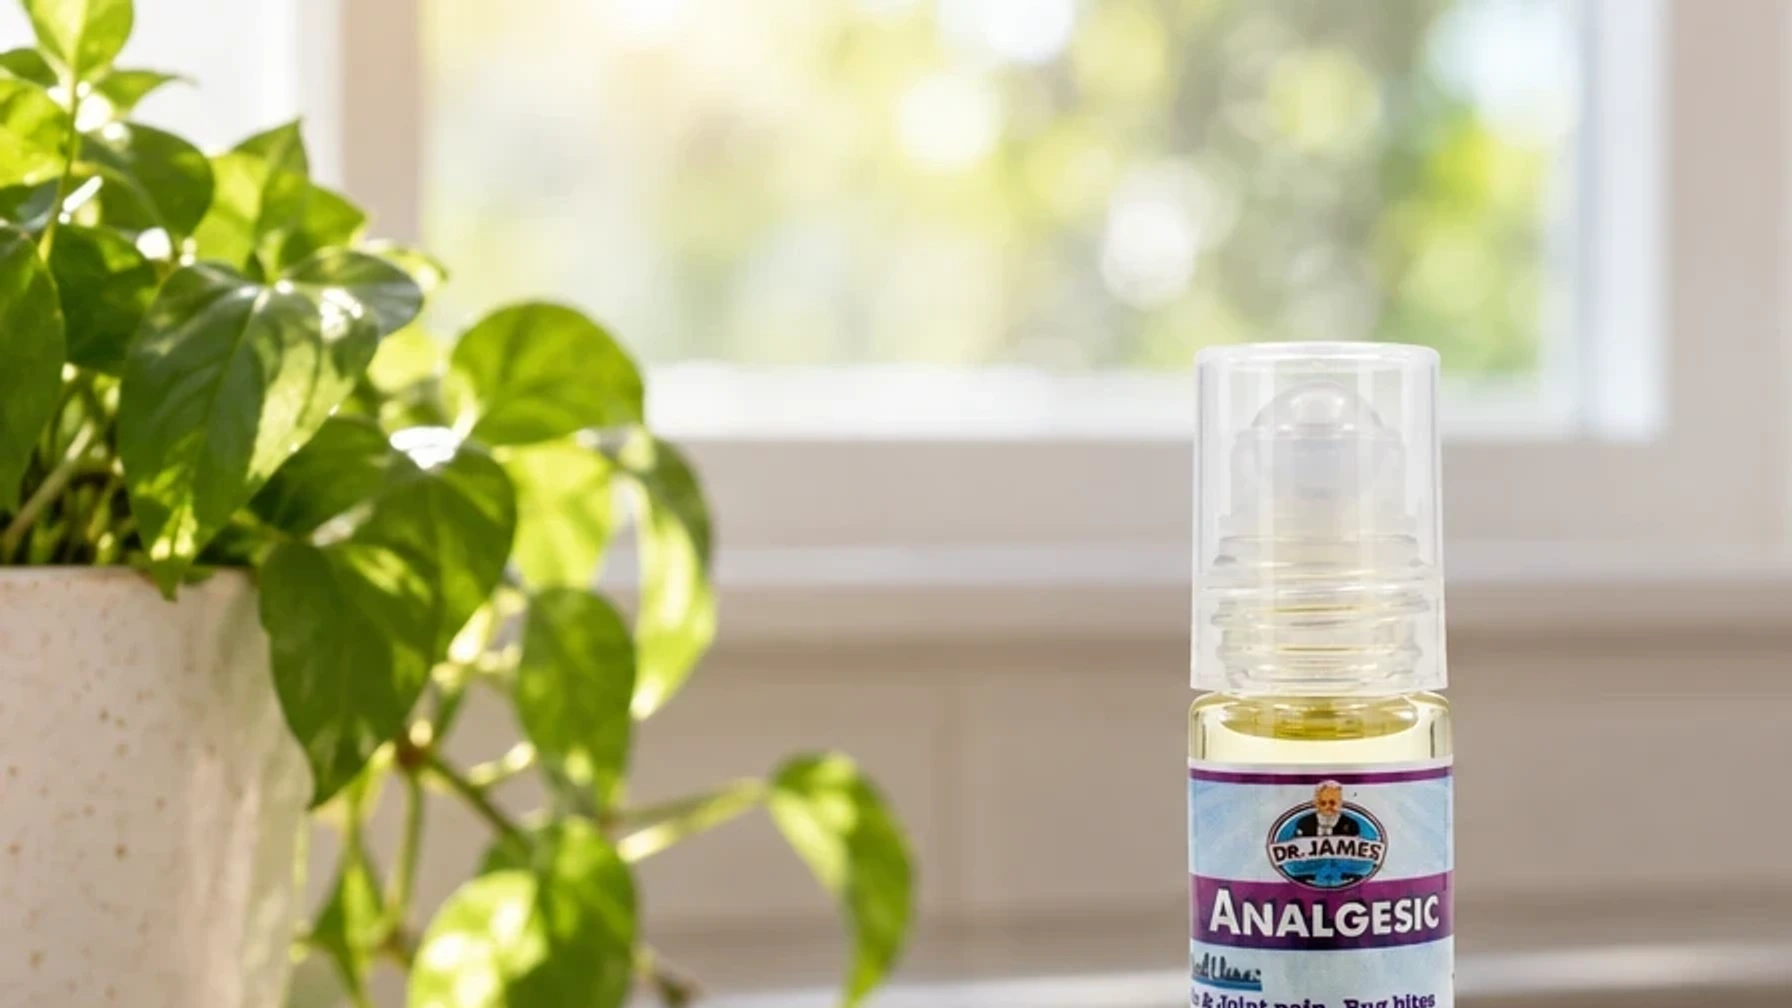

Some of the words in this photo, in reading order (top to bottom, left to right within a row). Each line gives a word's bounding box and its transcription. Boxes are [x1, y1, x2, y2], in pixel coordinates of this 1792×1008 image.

[1272, 844, 1306, 862] DR.
[1308, 838, 1382, 860] JAMES
[1209, 888, 1439, 937] ANALGESIC
